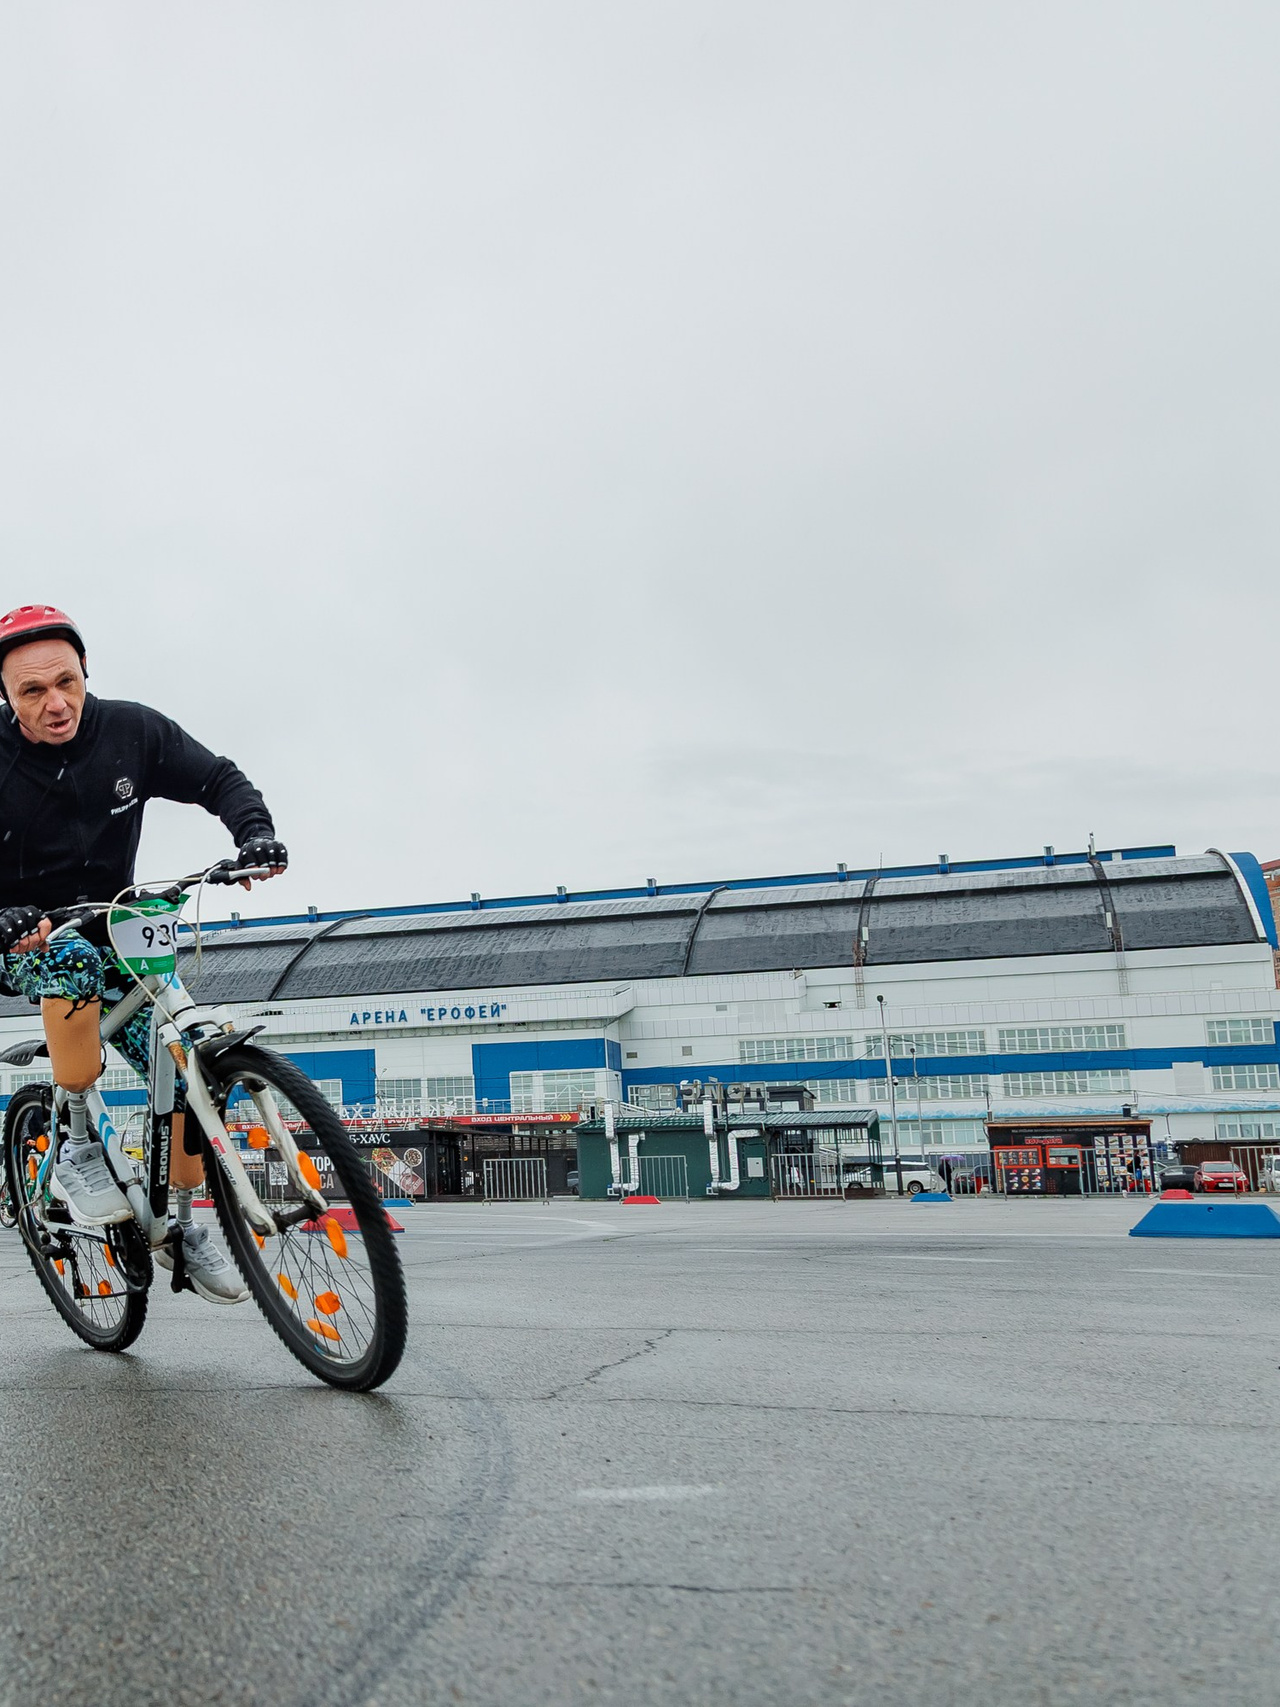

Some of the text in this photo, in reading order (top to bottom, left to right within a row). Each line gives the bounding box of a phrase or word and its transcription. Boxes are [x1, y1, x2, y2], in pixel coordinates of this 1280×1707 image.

[349, 1002, 508, 1026] АРЕНА "ЕРОФЕЙ"
[471, 1114, 554, 1124] ВХОД ЦЕНТРАЛЬНЫЙ
[159, 1125, 170, 1186] CRONUS
